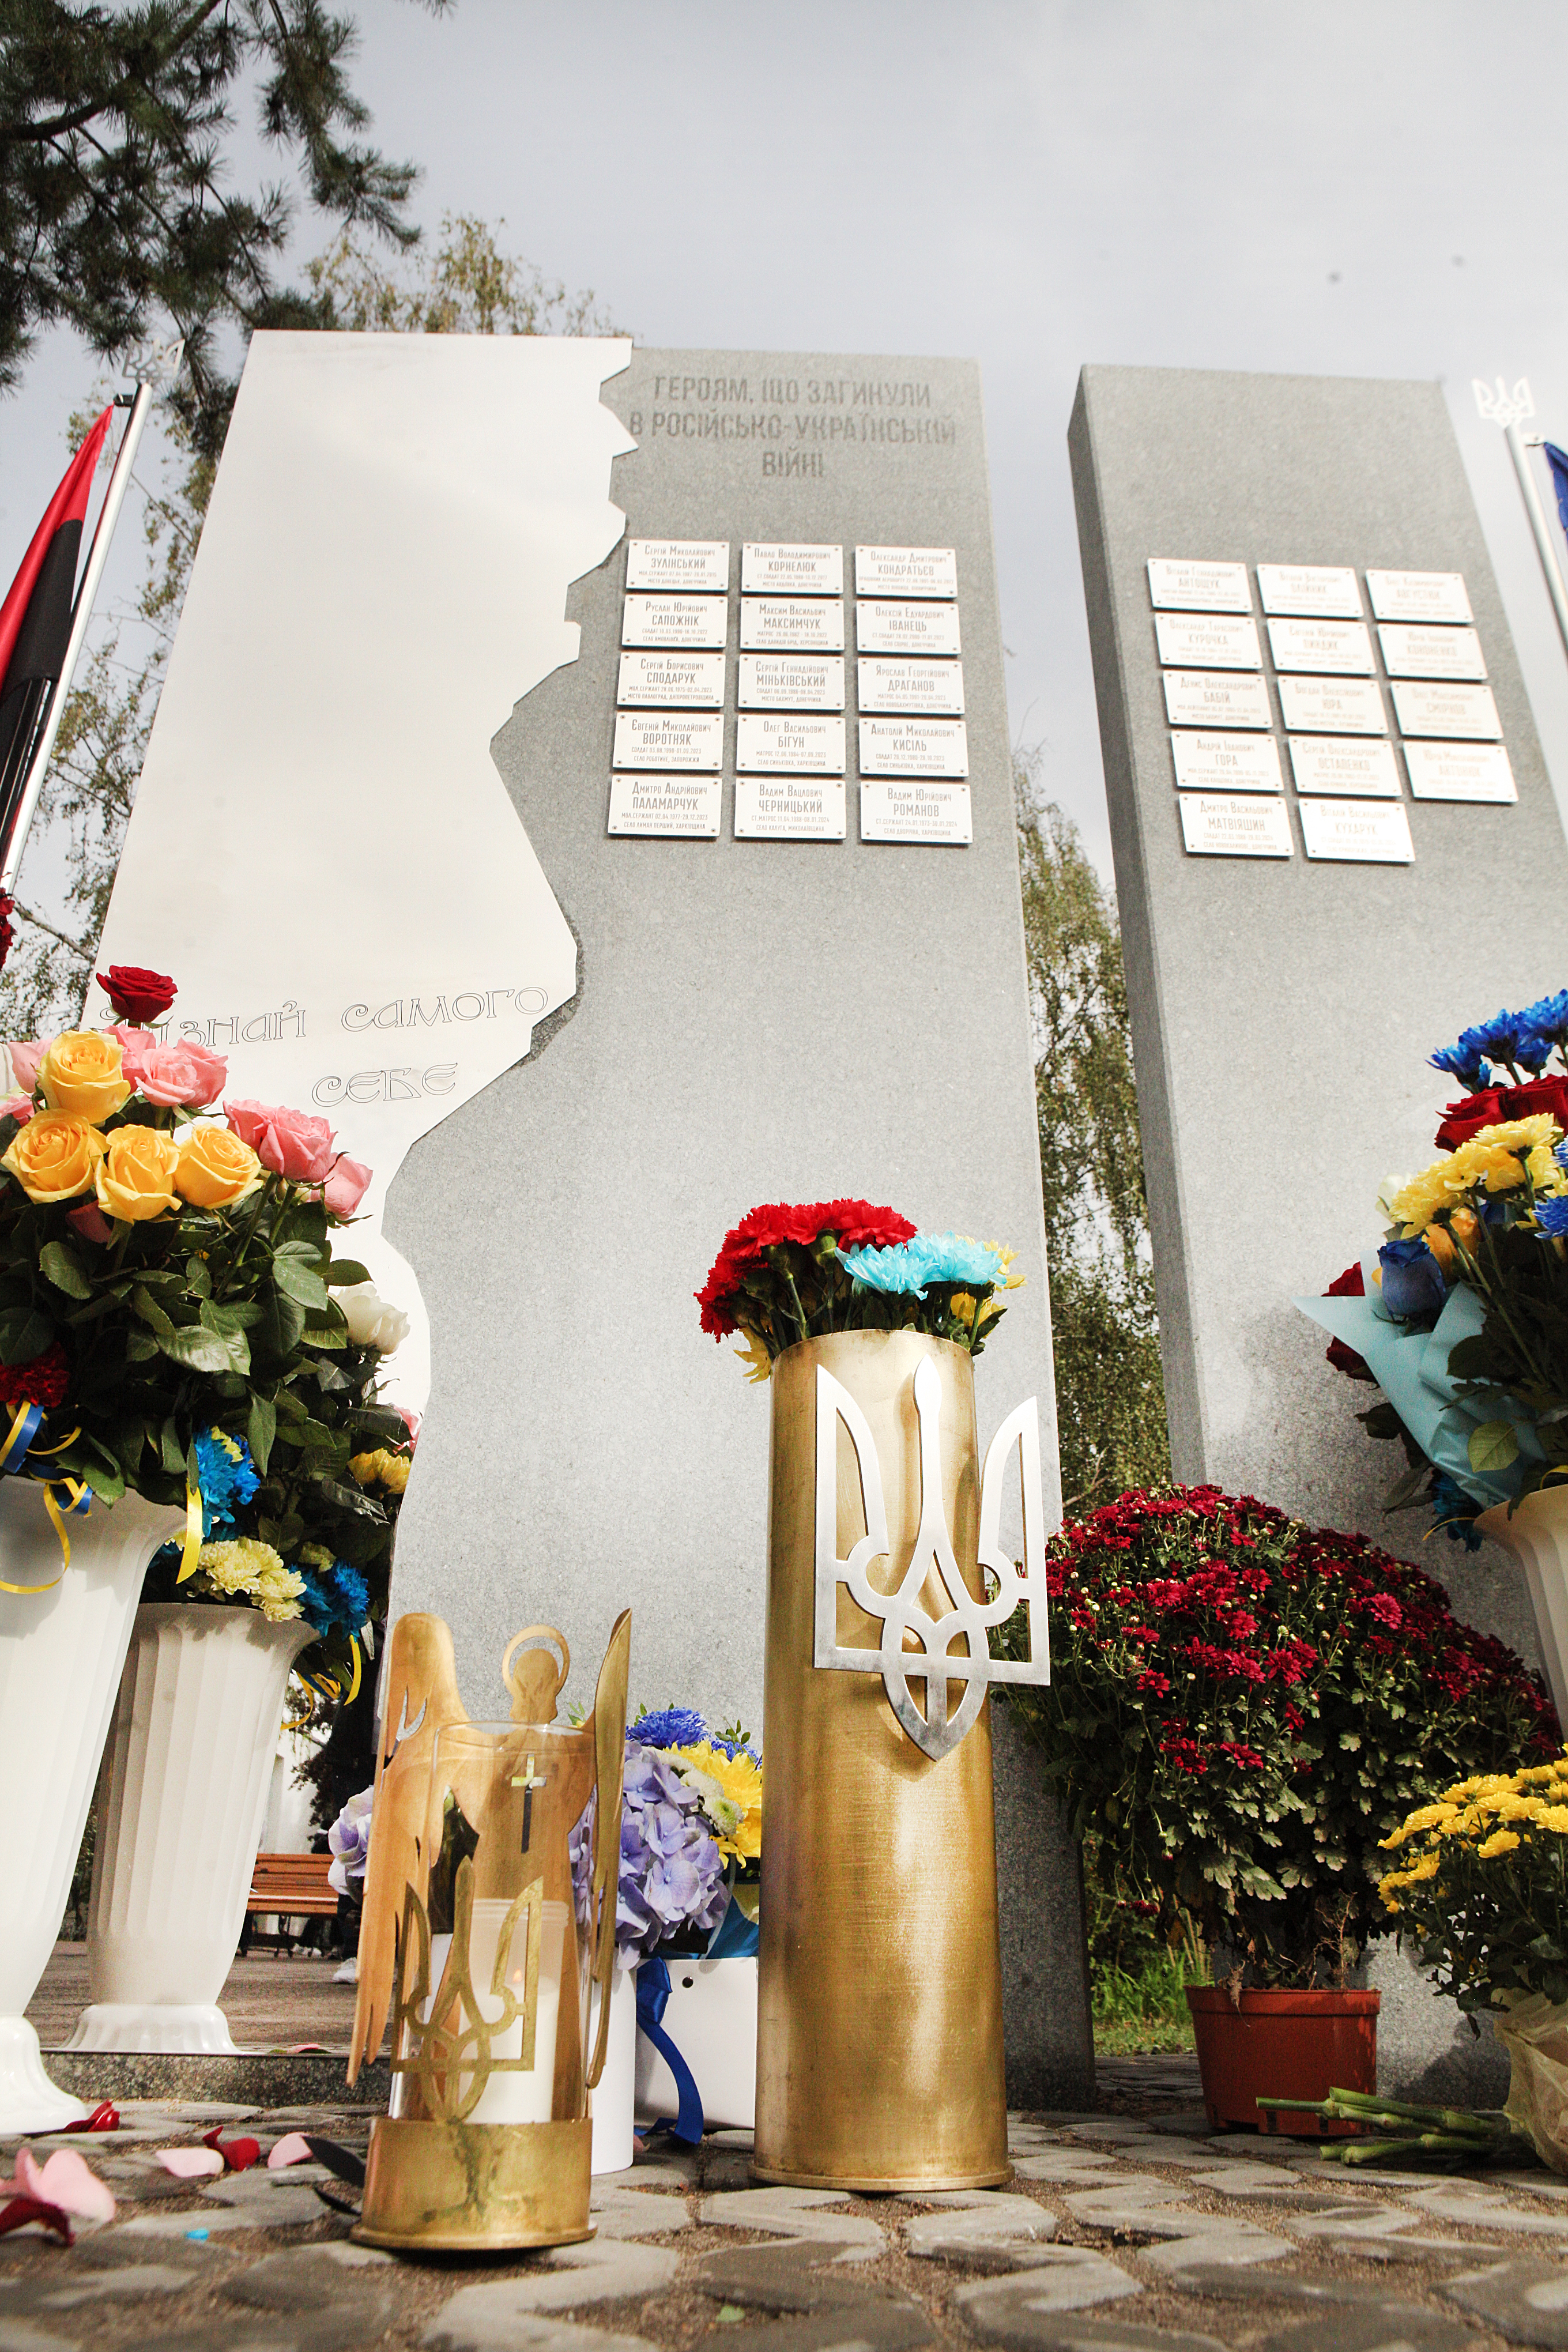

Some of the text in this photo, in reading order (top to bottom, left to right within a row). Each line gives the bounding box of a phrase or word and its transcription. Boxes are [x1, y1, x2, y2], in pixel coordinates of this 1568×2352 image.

[654, 376, 930, 407] ГЕРОЯМ, ЩО ЗАГИНУЛИ
[630, 408, 956, 445] В РОСІЙСЬКО-УКРАЇНСЬКІЙ
[762, 446, 824, 477] ВІЙНІ
[651, 558, 706, 568] ЗУЛІНСЬКИЙ
[768, 561, 816, 572] КОРНЕЛЮК
[878, 564, 934, 576] КОНДРАТЬЄВ
[646, 601, 707, 612] РУСЛАН ЮРІЙОВИЧ
[759, 604, 787, 615] МАКСИМ
[876, 606, 944, 619] ОЛЕКСІЙ ЕДУАРДОВИЧ
[652, 615, 699, 625] САПОЖНІК
[764, 617, 821, 629] МАКСИМЧУК
[889, 620, 927, 632] ІВАНЕЦЬ
[641, 658, 704, 670] СЕРГІЙ БОРИСОВИЧ
[756, 661, 828, 673] СЕРГІЙ ГЕННАДІЙОВИЧ
[876, 665, 949, 677] ЯРОСЛАВ ГЕОРГІЙОВИЧ
[647, 672, 696, 684] СПОДАРУК
[757, 674, 826, 687] МІНЬКІВСЬКИЙ
[1180, 676, 1257, 690] ДЕНИС ОЛЕКСАНДРОВИЧ
[888, 680, 935, 692] ДРАГАНОВ
[1204, 691, 1231, 703] БАБІЙ
[632, 719, 711, 732] ЄВГЕНІЙ МИКОЛАЙОВИЧ
[764, 721, 826, 733] ОЛЕГ ВАСИЛЬОВИЧ
[871, 723, 955, 737] АНАТОЛІЙ МИКОЛАЙОВИЧ
[643, 733, 692, 745] ВОРОТНЯК
[778, 736, 805, 748] БІГУН
[893, 739, 927, 751] КИСІЛЬ
[1197, 738, 1255, 751] АНДРІЙ ІВАНОВИЧ
[1302, 742, 1380, 756] СЕРГІЙ ОЛЕКСАНДРОВИЧ
[1215, 754, 1238, 766] ГОРА
[1318, 757, 1370, 771] ОСТАПЕНКО
[632, 782, 707, 795] ДМИТРО АНДРІЙОВИЧ
[760, 784, 823, 797] ВАДИМ ВАЦЛОВИЧ
[888, 787, 952, 801] ВАДИМ ЮРІЙОВИЧ
[633, 797, 699, 810] ПАЛАМАРЧУК
[759, 800, 823, 814] ЧЕРНИЦЬКИЙ
[1200, 800, 1272, 814] ДМИТРО ВАСИЛЬОВИЧ
[894, 804, 940, 817] РОМАНОВ
[1320, 805, 1389, 819] ВІТАЛІЙ ВАСИЛЬОВИЧ
[1208, 817, 1265, 831] МАТВІЯШИН
[1335, 823, 1377, 834] КУХАРУК
